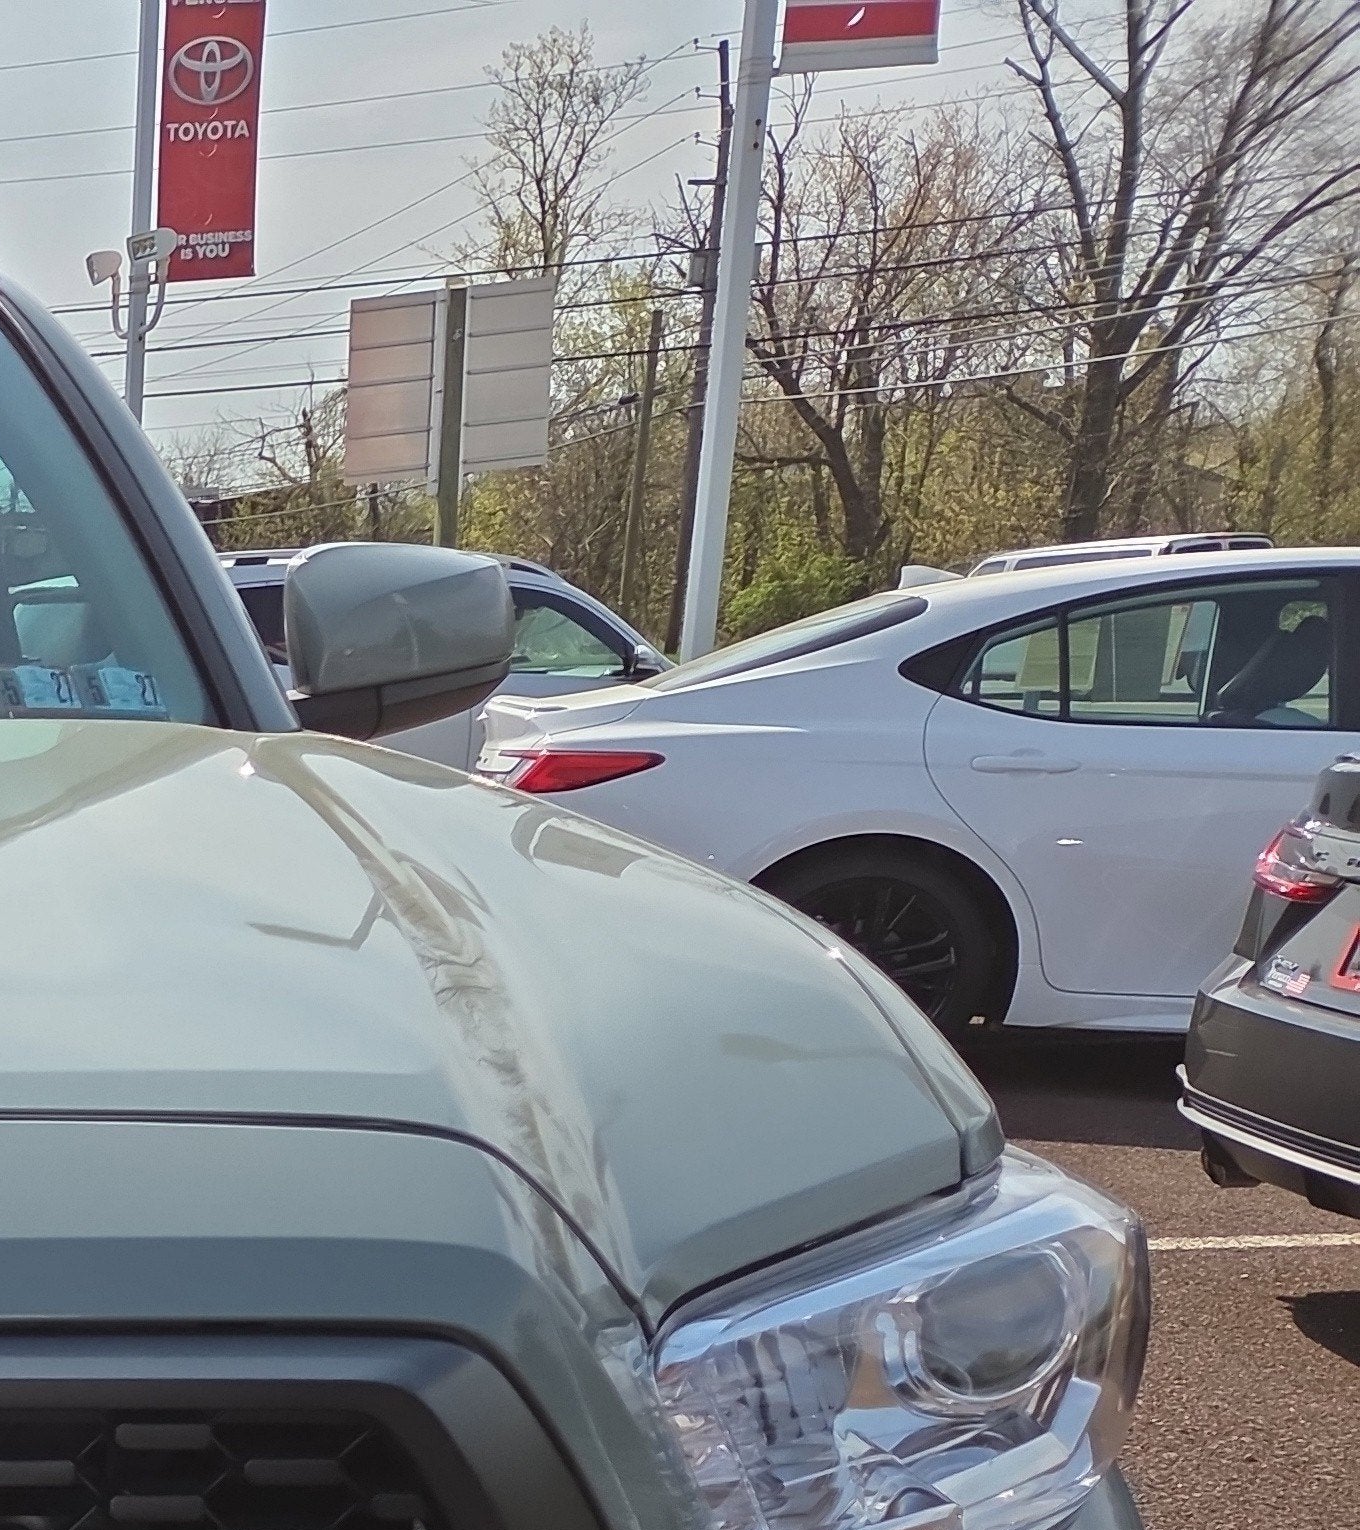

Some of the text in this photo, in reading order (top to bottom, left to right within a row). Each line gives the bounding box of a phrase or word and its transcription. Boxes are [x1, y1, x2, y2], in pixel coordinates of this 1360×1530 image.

[166, 119, 250, 143] TOYOTA
[188, 229, 252, 245] BUSINESS
[180, 243, 230, 260] IS YOU
